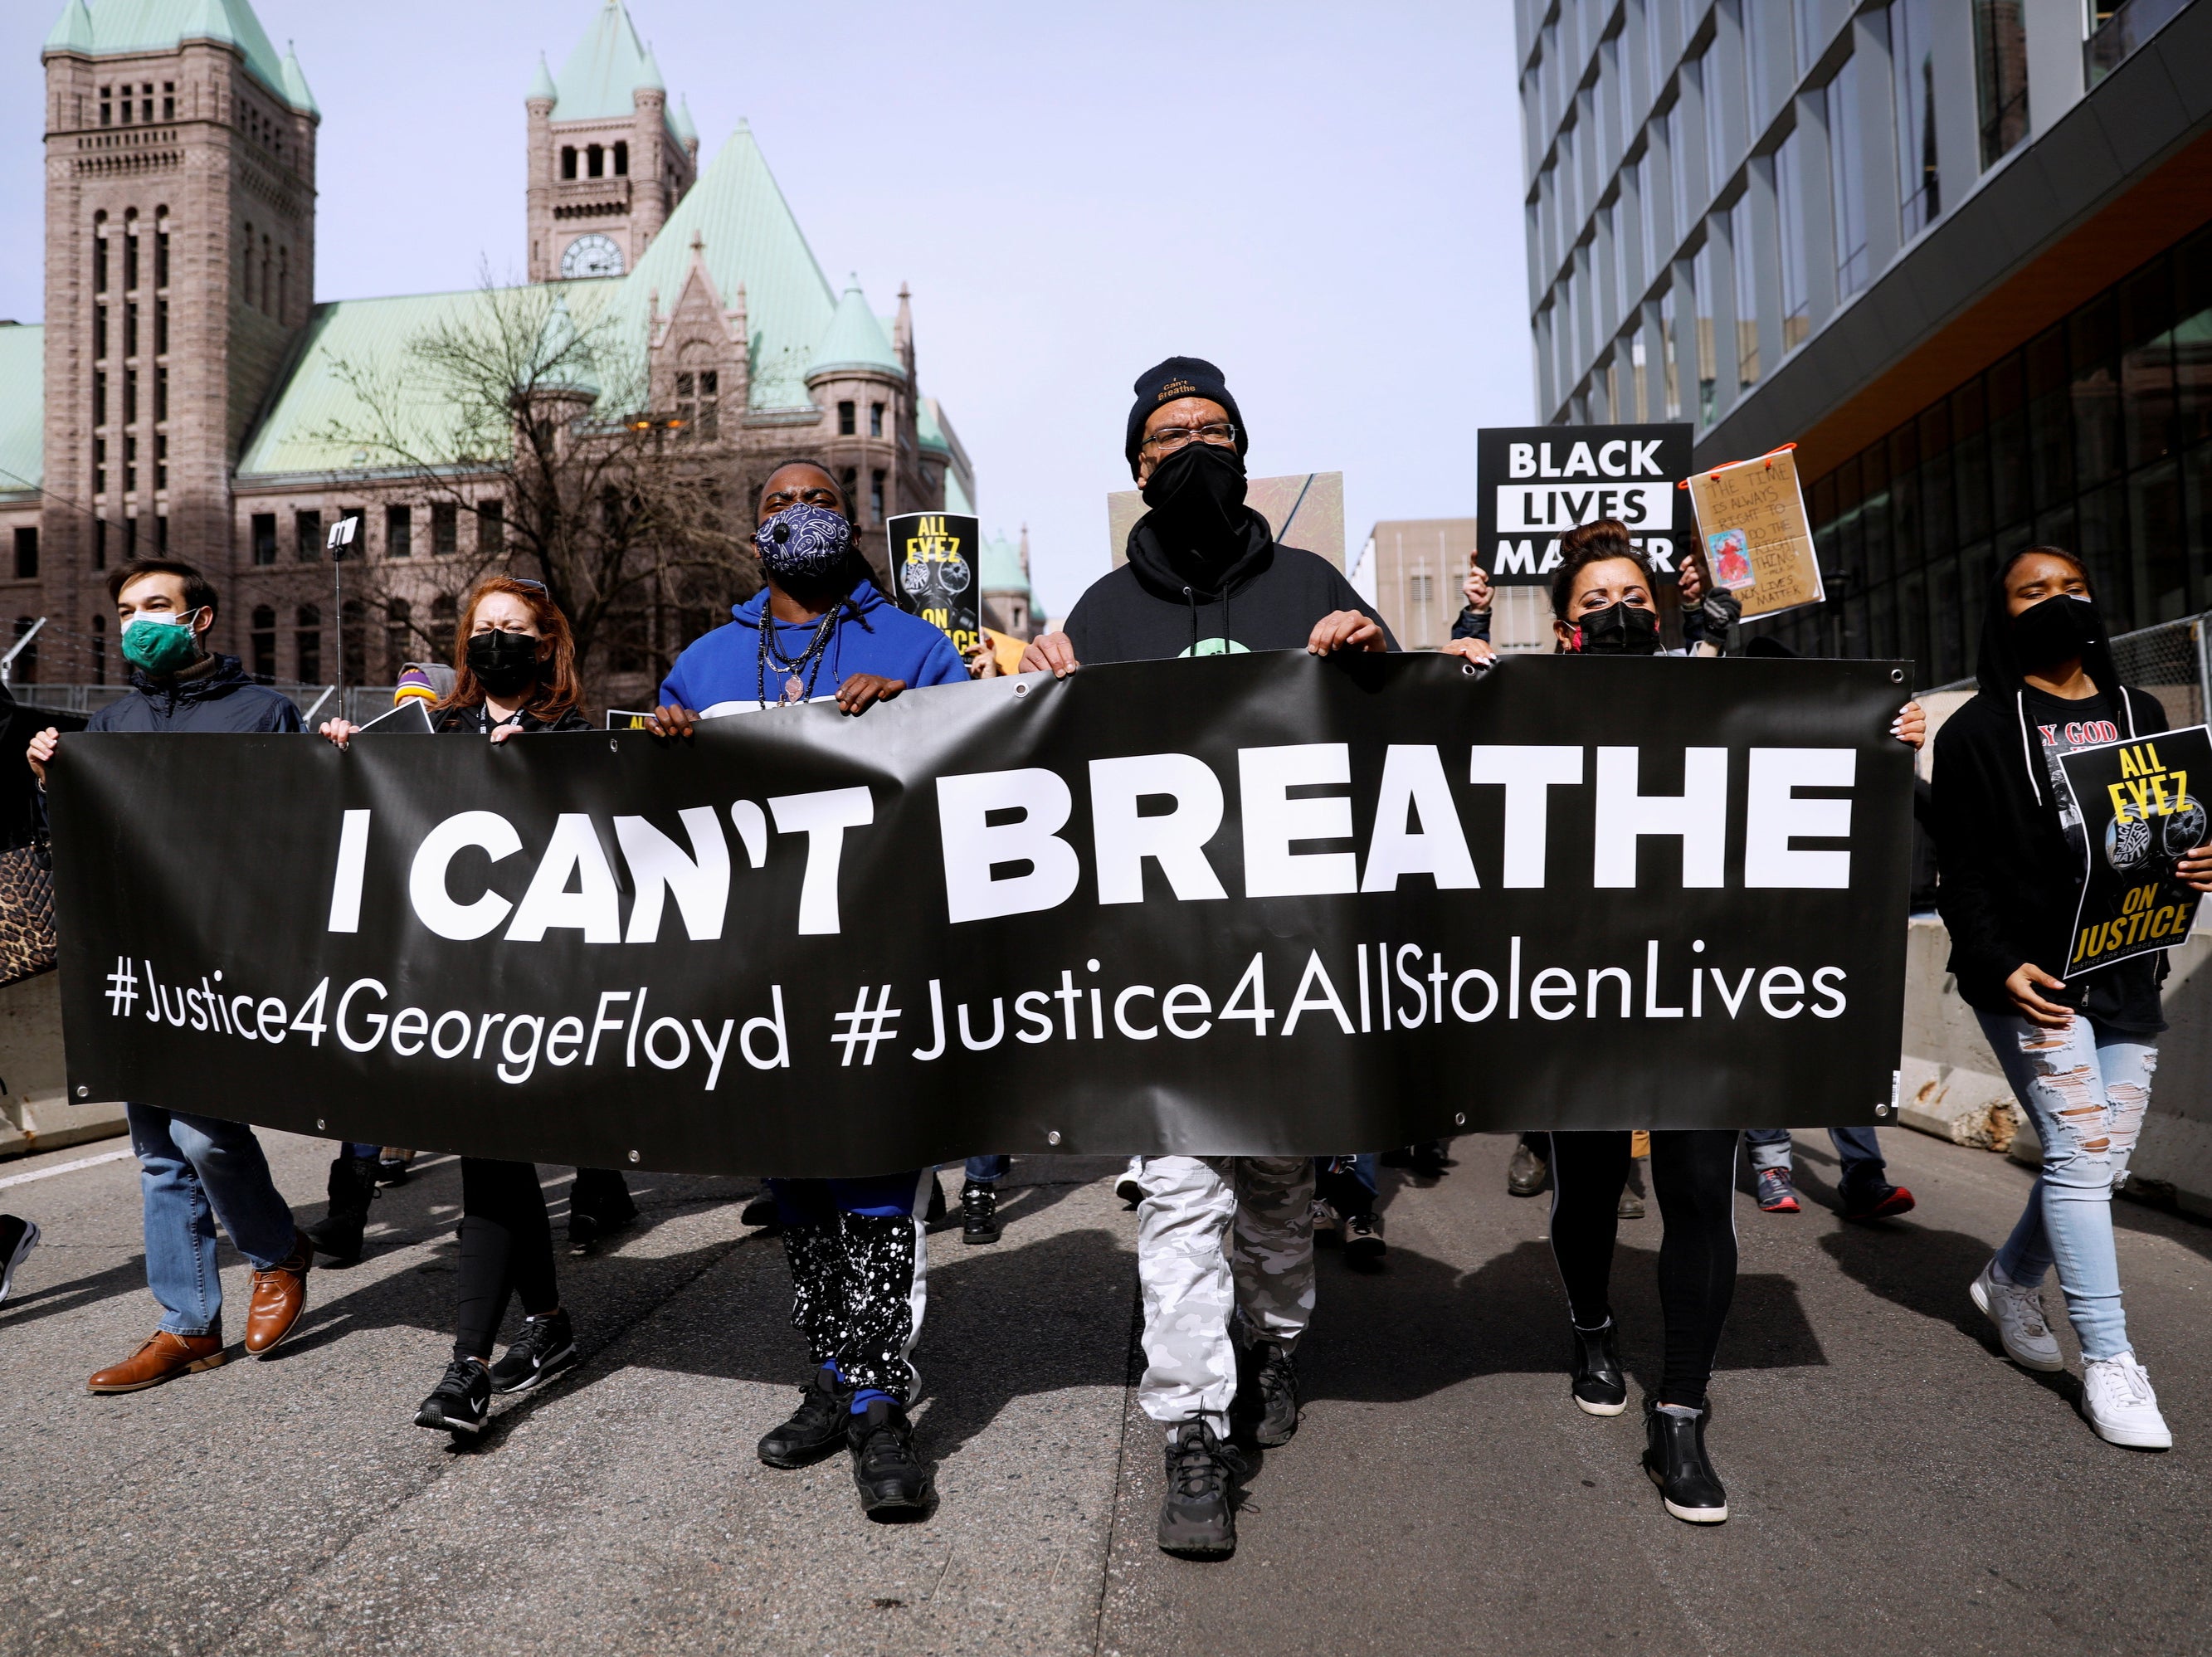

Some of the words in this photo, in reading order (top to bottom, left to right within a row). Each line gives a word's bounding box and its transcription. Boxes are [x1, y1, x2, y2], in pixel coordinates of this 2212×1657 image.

[1158, 384, 1196, 401] Breathe
[1163, 379, 1188, 391] Can't
[1508, 440, 1664, 479] BLACK
[1706, 479, 1739, 499] THE
[1746, 463, 1790, 486] TIME
[1523, 490, 1647, 525] LIVES
[1713, 502, 1727, 514] IS
[1731, 486, 1779, 509] ALWAYS
[918, 516, 948, 537] ALL
[1719, 508, 1759, 531] RIGHT
[1766, 503, 1786, 515] TO
[1748, 528, 1766, 540] DO
[1767, 519, 1793, 534] THE
[906, 537, 961, 565] EYEZ
[1493, 538, 1676, 575] MAR
[1754, 534, 1796, 555] RIGHT
[1752, 548, 1795, 570] THING
[1735, 587, 1760, 601] LACK
[1761, 575, 1793, 592] LIVES
[1756, 584, 1801, 607] MATTER
[922, 608, 948, 629] ON
[630, 715, 646, 729] AL
[2065, 720, 2118, 745] GOD
[2119, 743, 2166, 779] ALL
[2107, 770, 2194, 824] EYEZ
[328, 809, 371, 933] I
[408, 785, 875, 944] CAN'T
[935, 743, 1857, 924] BREATHE
[2122, 882, 2159, 915] ON
[2073, 903, 2194, 963] JUSTICE
[2070, 957, 2101, 972] JUSTICE
[2103, 950, 2118, 961] FOR
[2121, 942, 2152, 954] GEORGE
[2156, 935, 2183, 944] FLOYD
[105, 955, 790, 1091] #Justice4GeorgeFloyd
[831, 936, 1847, 1067] #Justice4AllStolenLives
